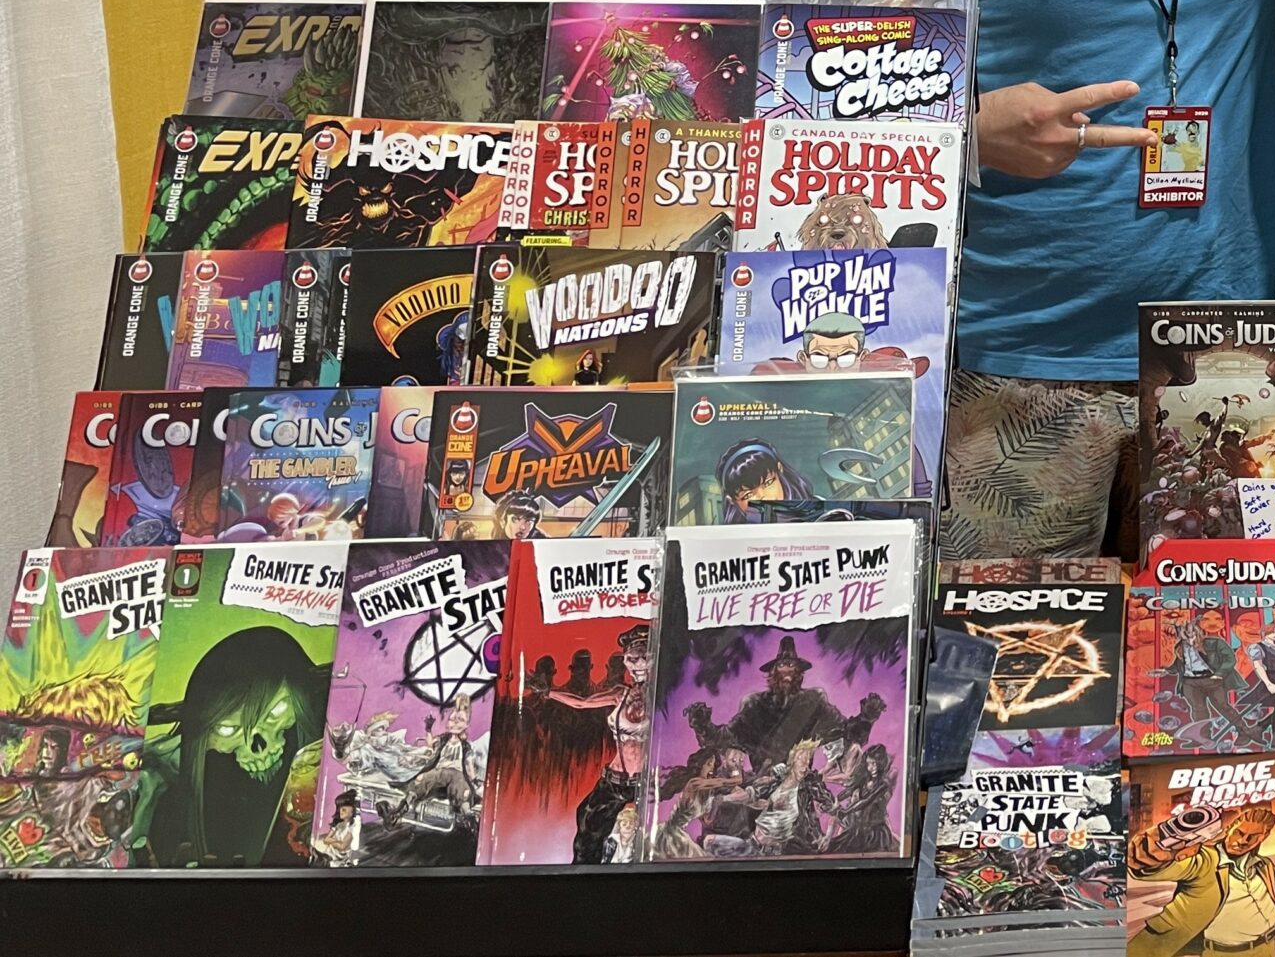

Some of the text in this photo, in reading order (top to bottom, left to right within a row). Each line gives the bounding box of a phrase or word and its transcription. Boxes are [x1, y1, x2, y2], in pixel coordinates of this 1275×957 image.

[812, 25, 831, 35] THE
[881, 31, 912, 41] COMIC
[203, 40, 223, 102] ORANGE CONE
[773, 40, 788, 104] ORANGE CONE
[811, 42, 943, 88] Cottage
[836, 72, 952, 117] Cheese
[347, 128, 511, 176] HOSPICE
[792, 128, 933, 143] CANADA DAY SPECIAL
[626, 128, 647, 221] HORROR
[782, 139, 941, 175] HOLIDAY
[164, 154, 189, 223] ORANGE CONE
[305, 153, 328, 223] ORANGE CONE
[514, 130, 534, 224] HORROR
[595, 130, 613, 224] HORROR
[742, 129, 761, 224] HORROR
[769, 170, 947, 211] SPIRITS
[1143, 191, 1204, 202] EXHIBITOR
[791, 255, 892, 301] PUP VAN
[122, 285, 144, 357] ORANGE CONE
[190, 285, 211, 358] ORANGE CONE
[383, 282, 460, 328] VOODOO
[486, 284, 506, 358] ORANGE CONE
[525, 255, 698, 350] VOODOO
[292, 290, 310, 364] ORANGE CONE
[732, 290, 748, 362] ORANGE CONE
[1151, 319, 1225, 346] COINS
[250, 413, 352, 448] COINS
[448, 441, 473, 452] CONE
[249, 455, 357, 479] THE GAMBLER
[483, 443, 632, 495] UPHEAVAL
[1242, 483, 1266, 493] Coins
[182, 568, 190, 585] 1
[244, 554, 315, 585] GRANITE
[550, 559, 628, 593] GRANITE
[695, 544, 890, 592] GRANITE STATE PUNK
[952, 562, 1108, 583] HOSPICE
[1156, 559, 1218, 584] COINS
[61, 570, 157, 614] GRANITE
[263, 585, 339, 610] BREAKING
[358, 568, 457, 622] GRANITE
[558, 591, 658, 615] ONLY POSERS
[696, 579, 887, 624] LIVE FREE OR DIE
[943, 588, 1109, 613] HOSPICE
[1145, 596, 1220, 611] COINS
[975, 774, 1079, 794] GRANITE
[1168, 760, 1275, 789] BROKE
[981, 812, 1073, 832] PUNK
[991, 795, 1060, 811] STATE
[2, 829, 25, 859] LIVE
[965, 875, 992, 893] LIVE
